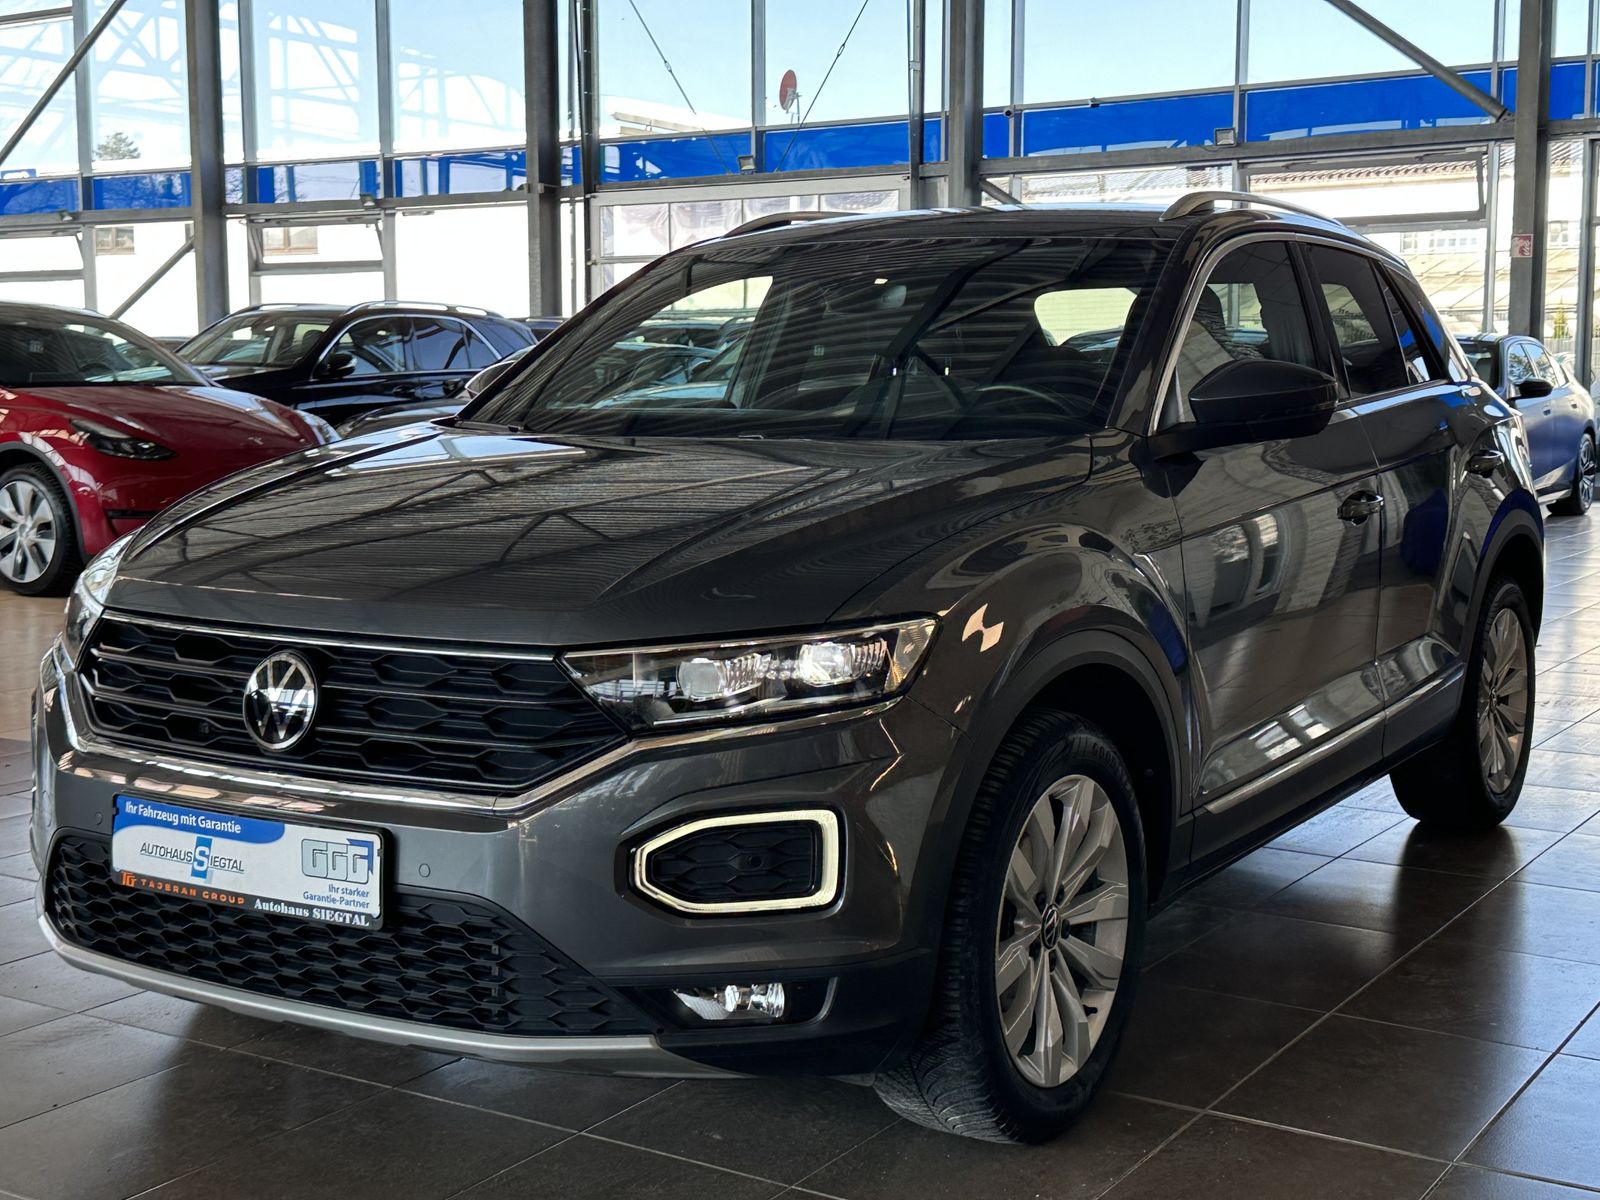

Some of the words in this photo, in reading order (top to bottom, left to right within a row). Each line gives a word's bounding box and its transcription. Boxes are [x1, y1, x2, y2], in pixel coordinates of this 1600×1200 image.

[125, 801, 137, 814] Ihr
[138, 804, 179, 826] Fahrzeug
[180, 814, 196, 826] mit
[198, 816, 241, 834] Garantie
[140, 842, 193, 862] AUTOHAUS
[193, 846, 245, 872] SIEGTAL
[202, 890, 245, 905] GROUP
[303, 891, 370, 909] Garantie-Partner
[328, 884, 340, 894] Ihr
[340, 885, 370, 898] starker
[254, 898, 310, 918] Autohaus
[312, 907, 370, 927] SIEGTAL
